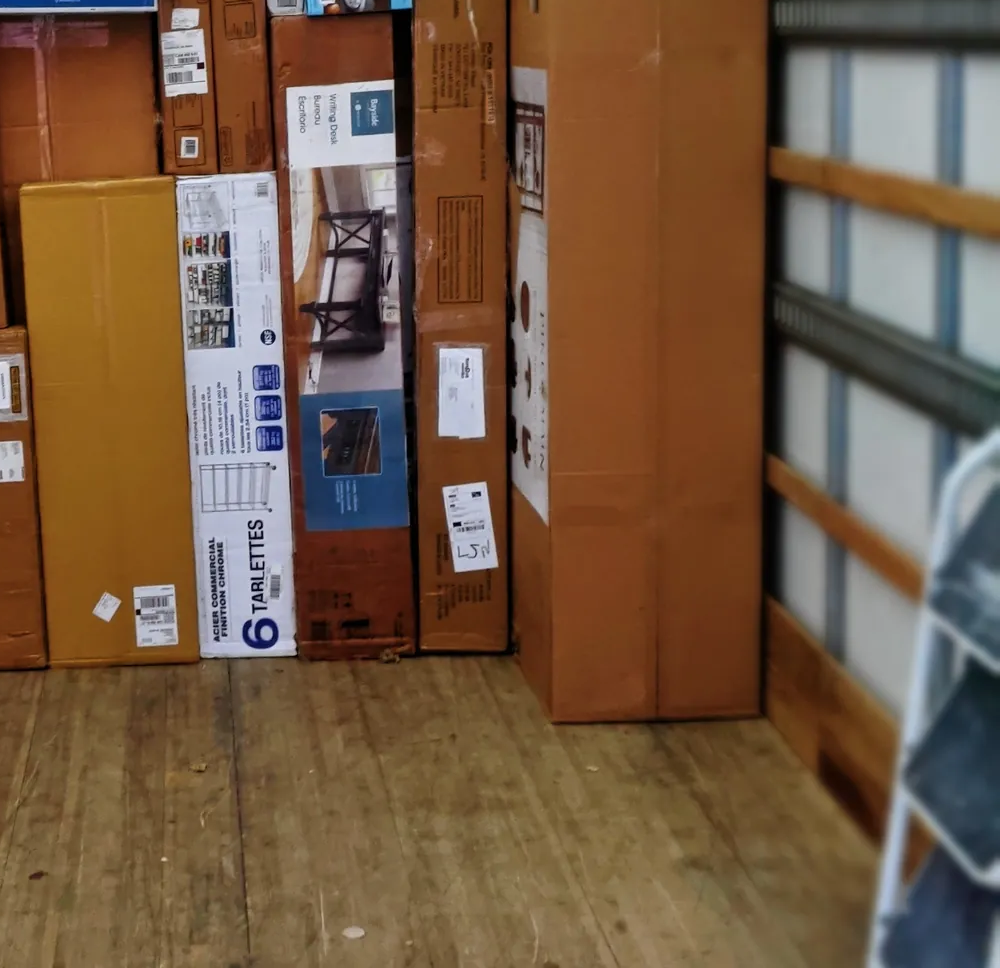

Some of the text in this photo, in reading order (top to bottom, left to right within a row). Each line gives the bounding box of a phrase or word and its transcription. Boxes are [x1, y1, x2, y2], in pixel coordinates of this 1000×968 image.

[313, 95, 321, 126] Bureau
[328, 94, 339, 145] Writing Desk
[368, 98, 379, 127] Bayside
[264, 330, 272, 344] NSF
[208, 536, 220, 642] ACIER COMMERCIAL
[219, 590, 228, 638] FINITION
[241, 617, 280, 650] 6
